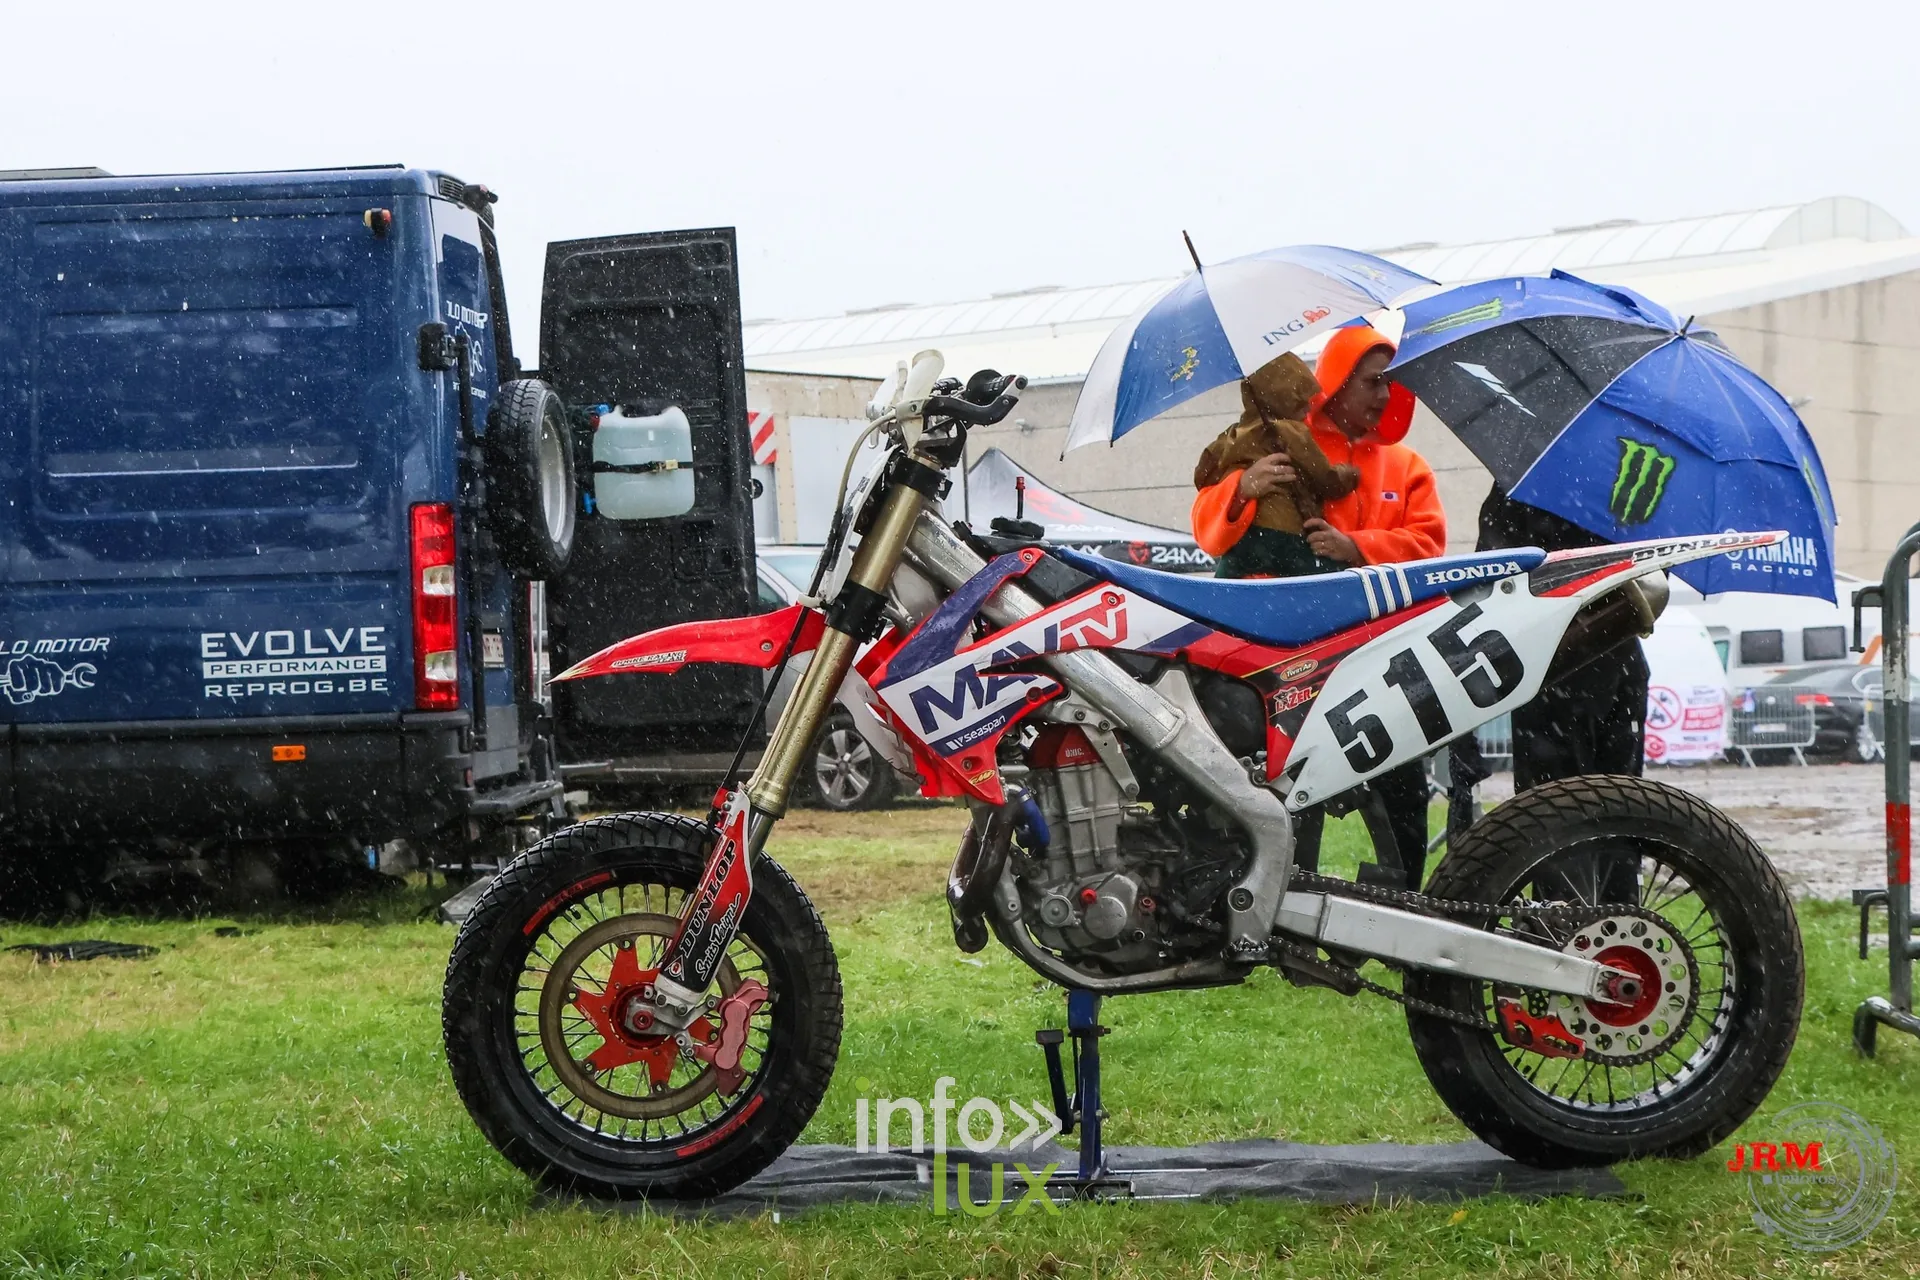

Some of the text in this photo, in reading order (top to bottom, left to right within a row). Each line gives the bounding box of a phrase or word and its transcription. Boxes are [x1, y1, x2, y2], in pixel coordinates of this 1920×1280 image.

[1262, 319, 1304, 346] ING
[1151, 546, 1216, 565] 24MX
[1633, 534, 1761, 563] DUNLOP
[1426, 560, 1523, 586] HONDA
[1731, 564, 1814, 577] RACING
[33, 637, 111, 654] MOTOR
[201, 626, 386, 658] EVOLVE
[210, 658, 382, 675] PERFORMANCE
[204, 678, 388, 698] REPROG.BE
[1276, 687, 1312, 713] LAZER
[1324, 602, 1525, 774] 515
[963, 714, 1006, 743] seaspan
[680, 838, 737, 959] DUNLOP
